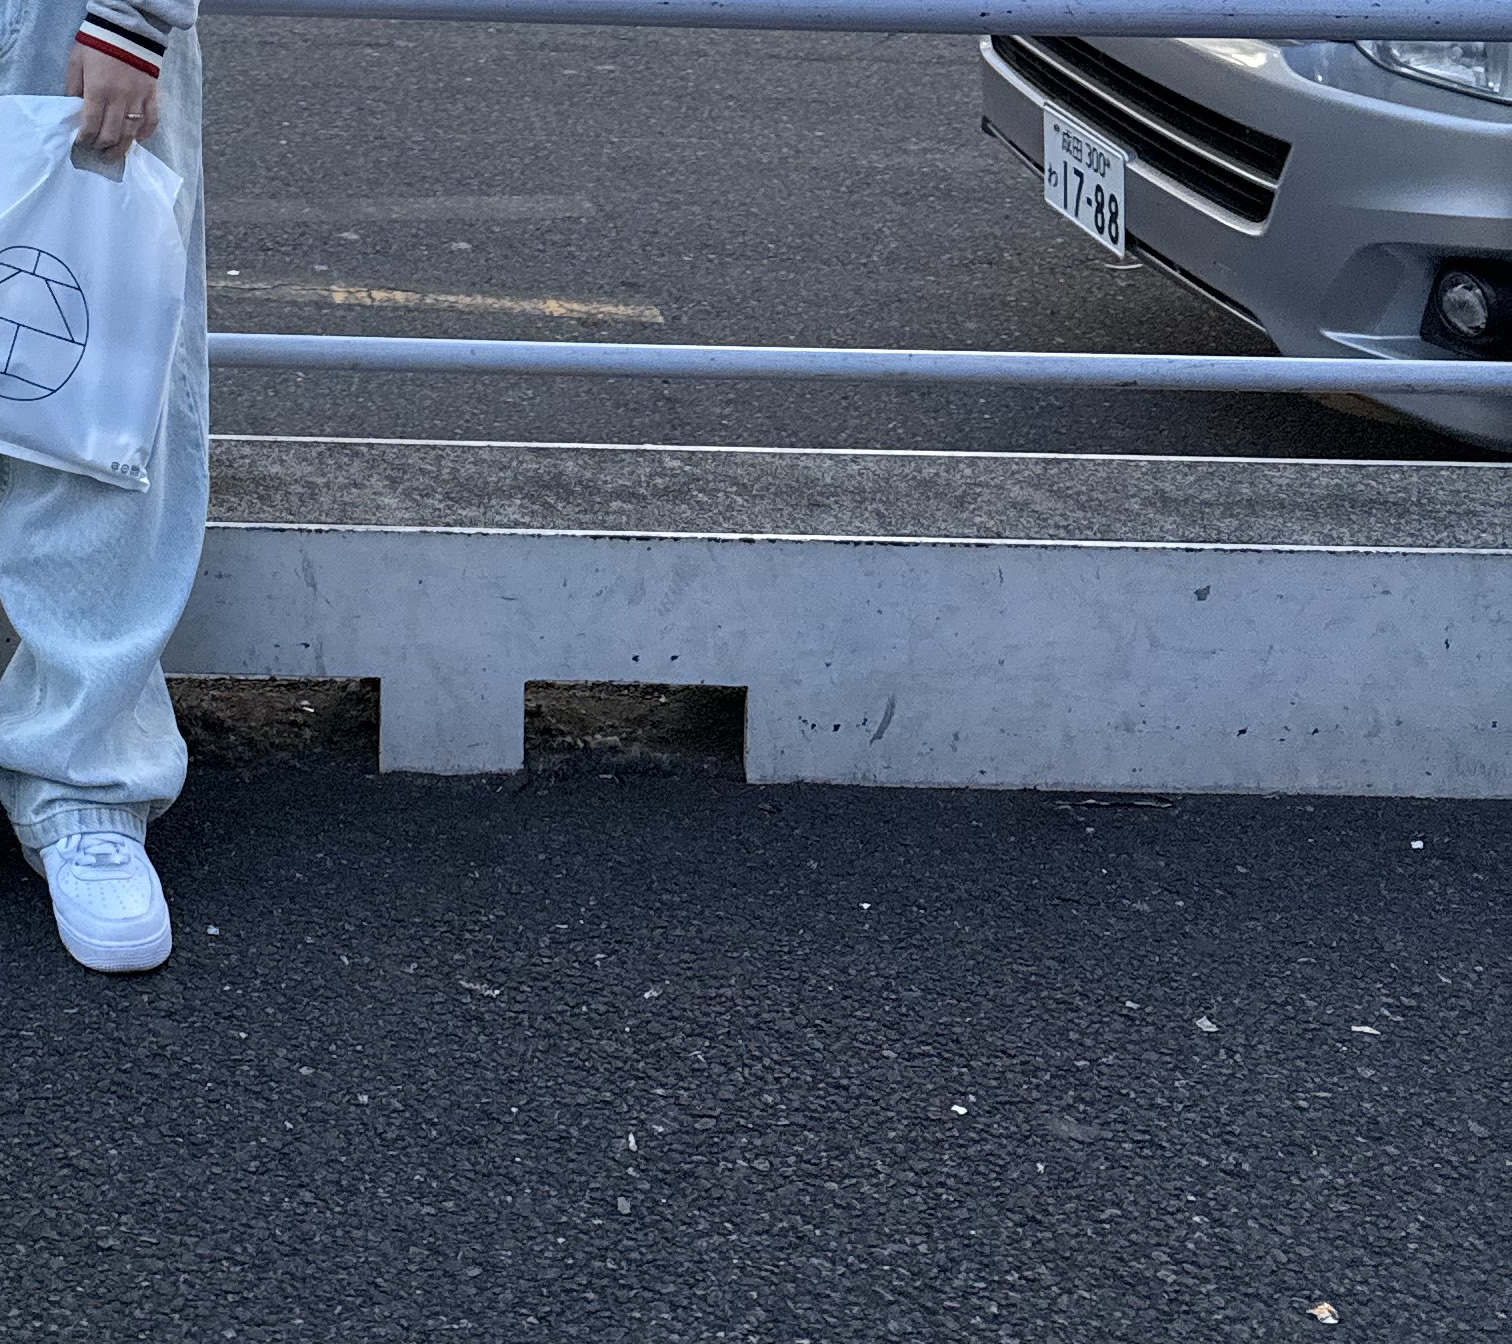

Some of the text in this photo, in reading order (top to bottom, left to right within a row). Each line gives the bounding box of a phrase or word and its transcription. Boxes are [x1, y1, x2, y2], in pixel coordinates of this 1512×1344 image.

[1062, 129, 1106, 178] 成田 300
[1047, 160, 1120, 246] わ 17-88
